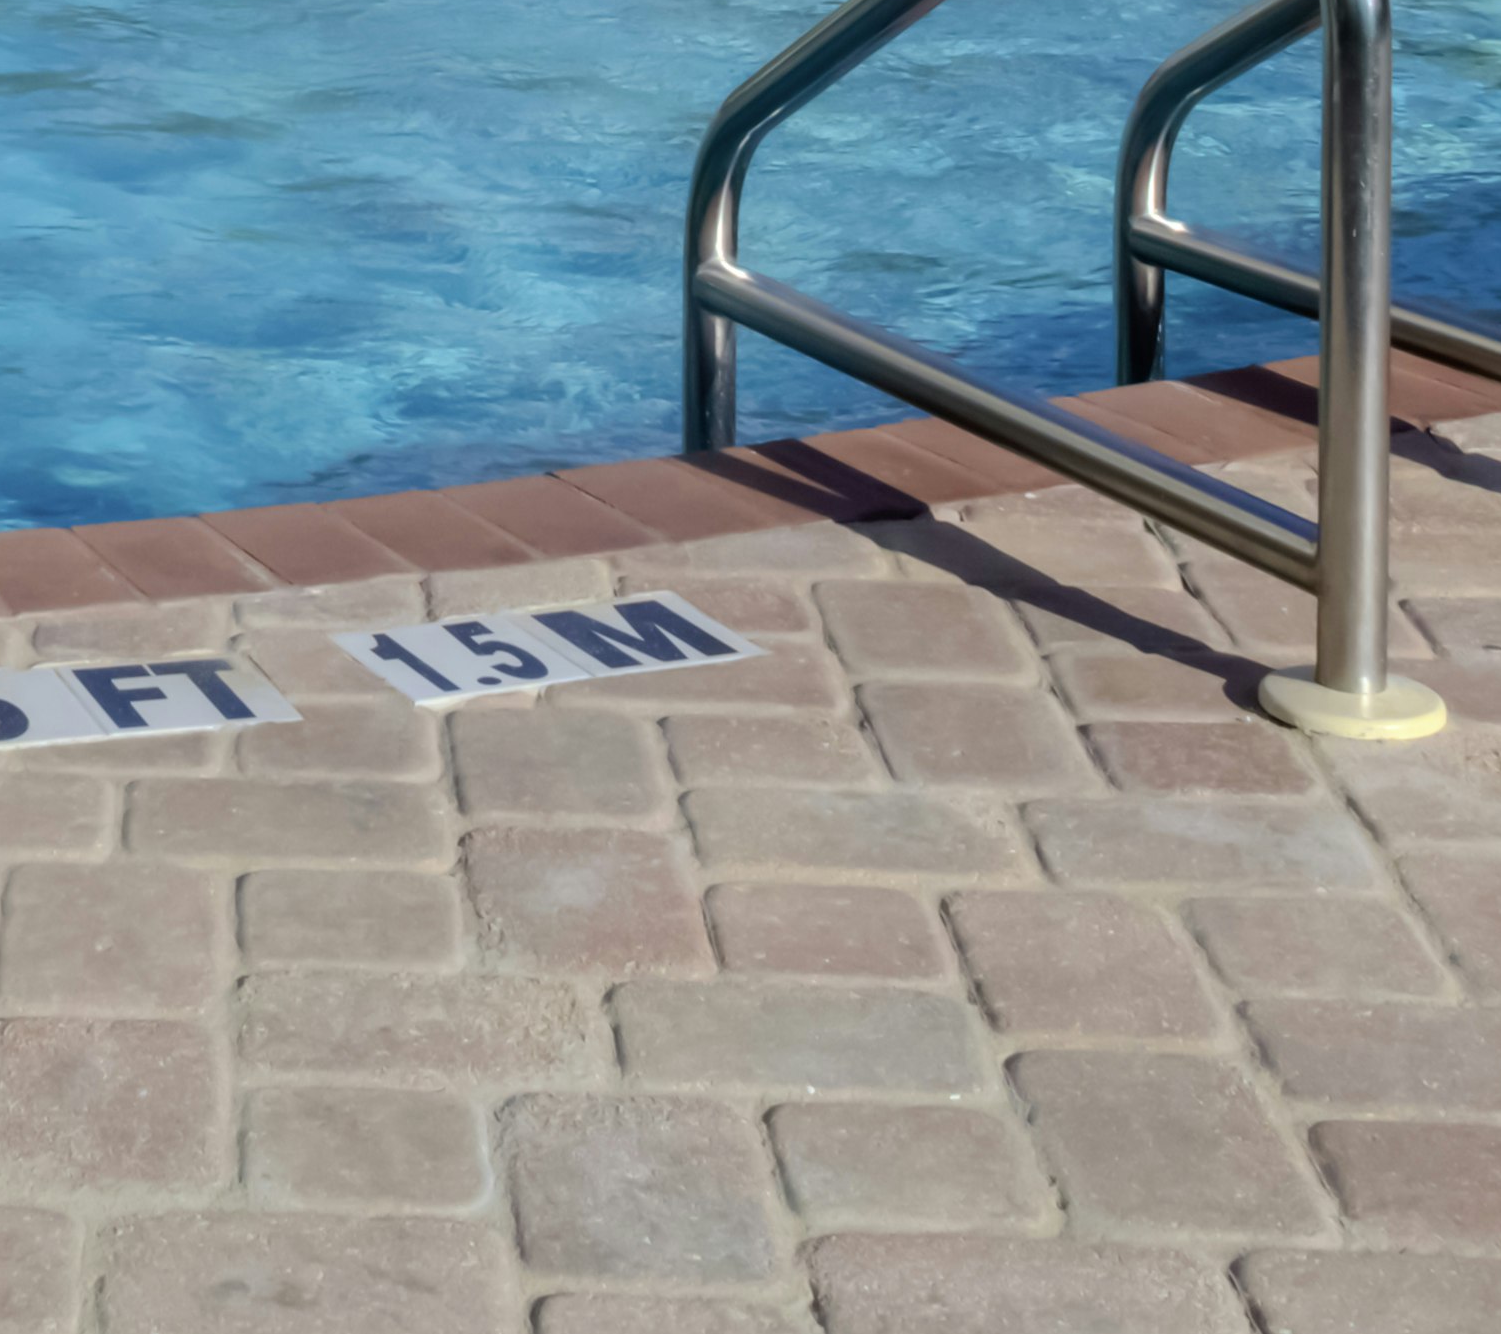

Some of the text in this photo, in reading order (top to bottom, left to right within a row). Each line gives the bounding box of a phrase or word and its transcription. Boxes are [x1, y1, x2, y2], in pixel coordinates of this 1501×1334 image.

[72, 658, 257, 729] FT
[369, 620, 549, 693] 1.5
[530, 599, 740, 670] M
